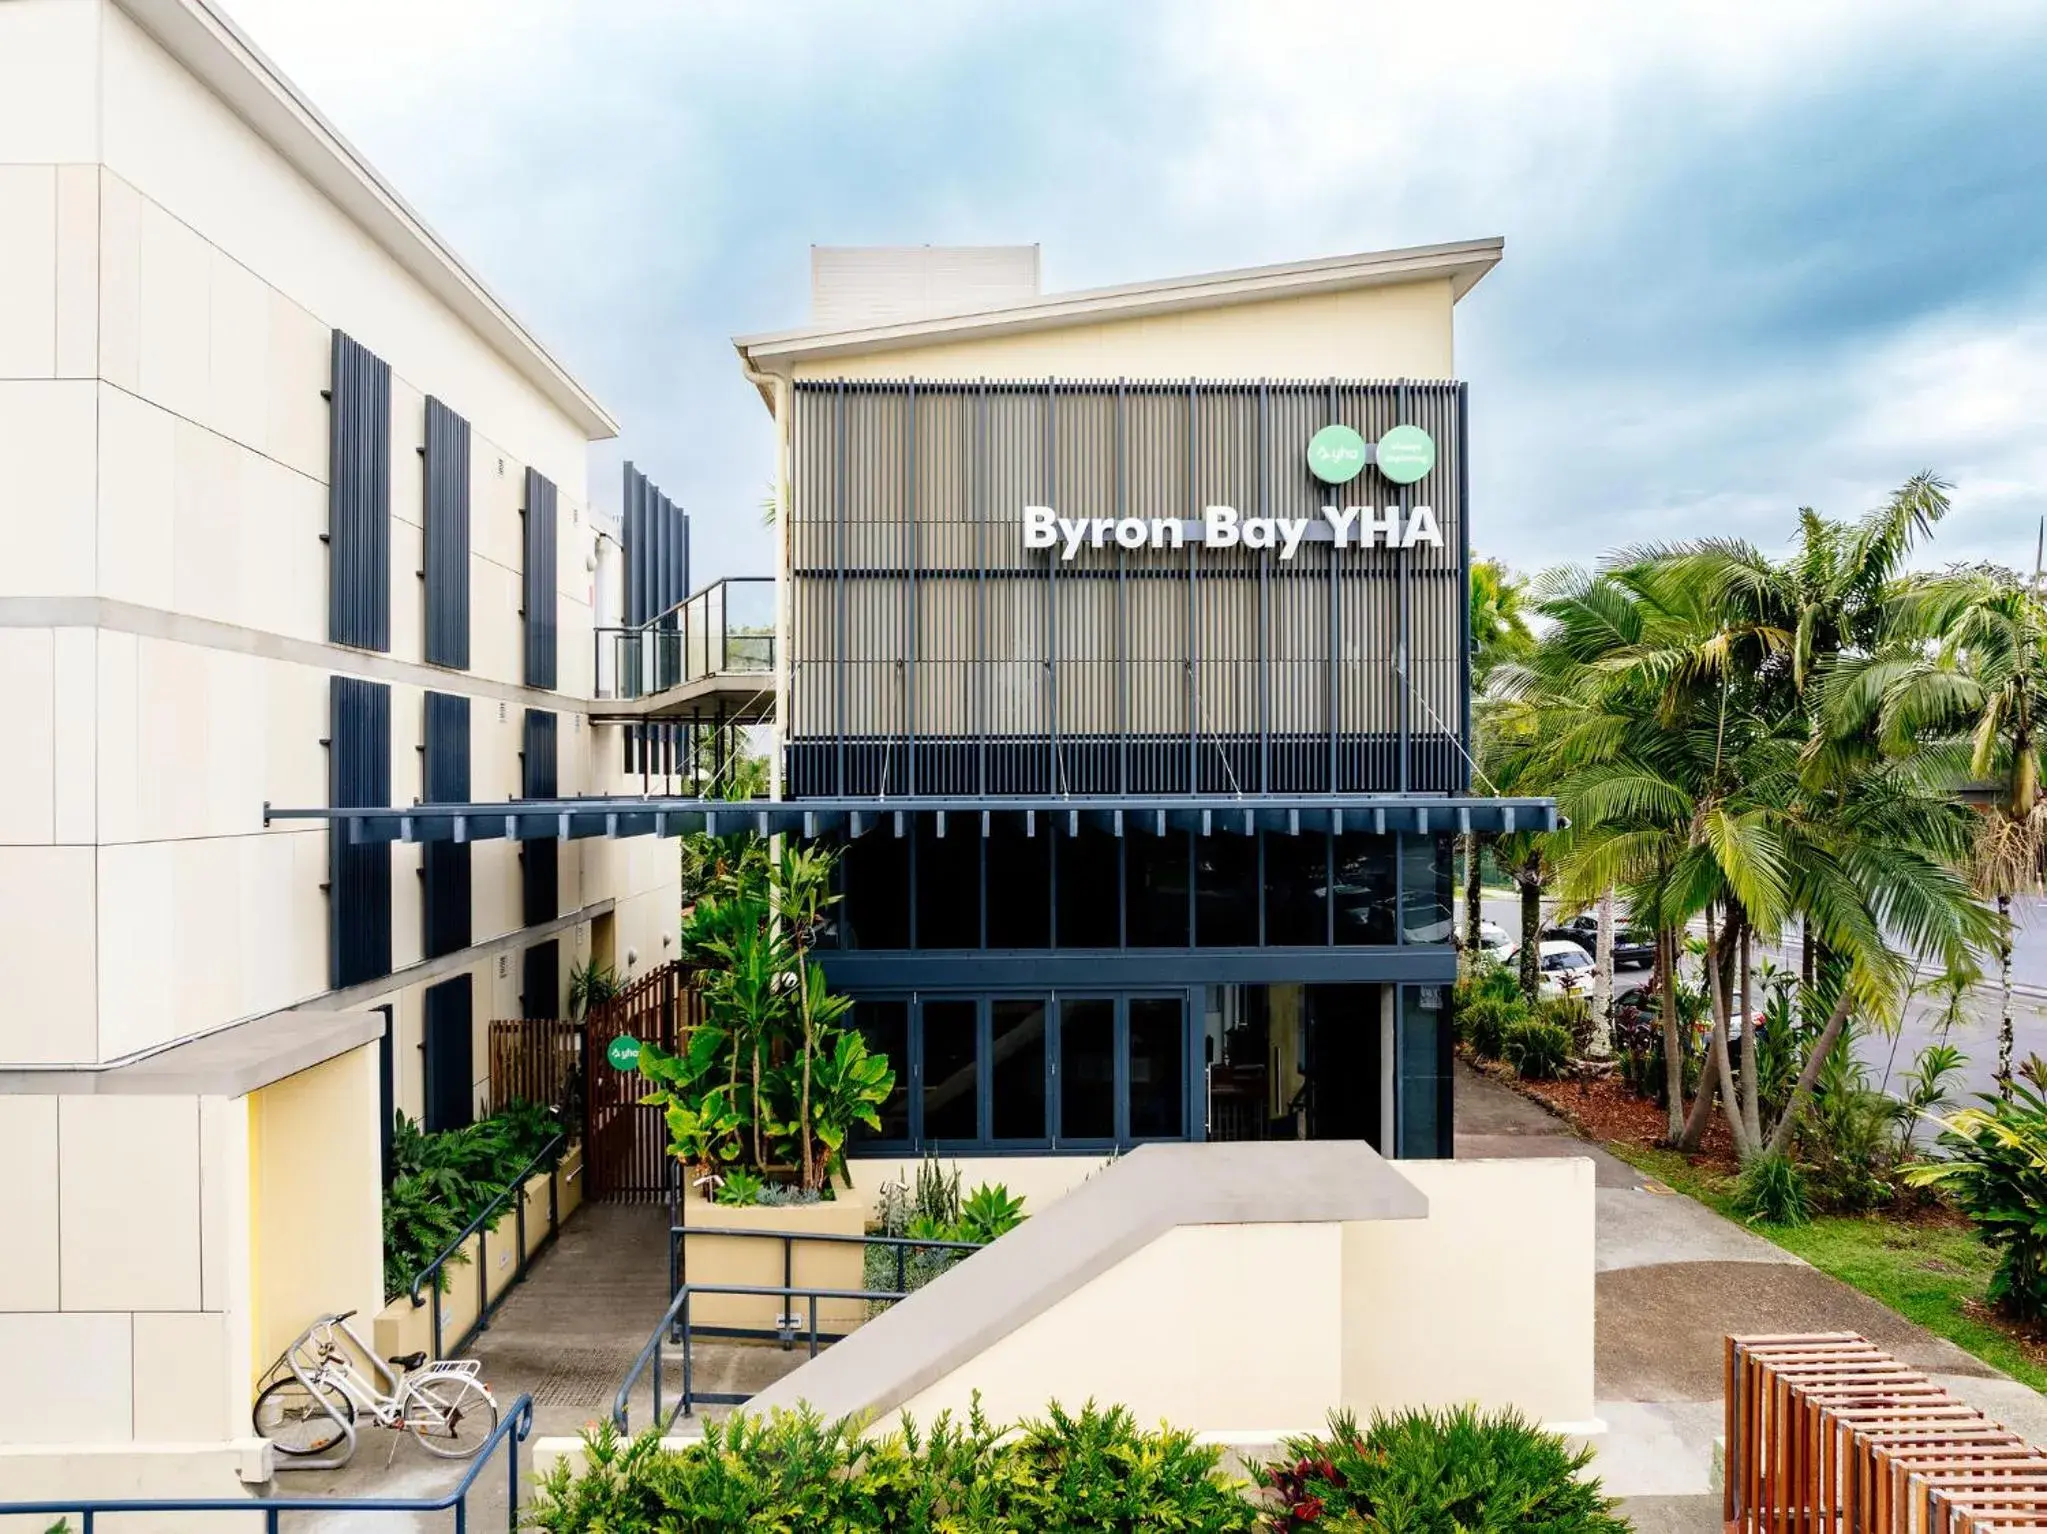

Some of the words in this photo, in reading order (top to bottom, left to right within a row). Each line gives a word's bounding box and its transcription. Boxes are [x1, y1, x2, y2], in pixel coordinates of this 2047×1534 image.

[1332, 445, 1358, 463] yha
[1024, 506, 1183, 560] Byron
[1205, 506, 1308, 560] Bay
[1322, 506, 1444, 548] YHA
